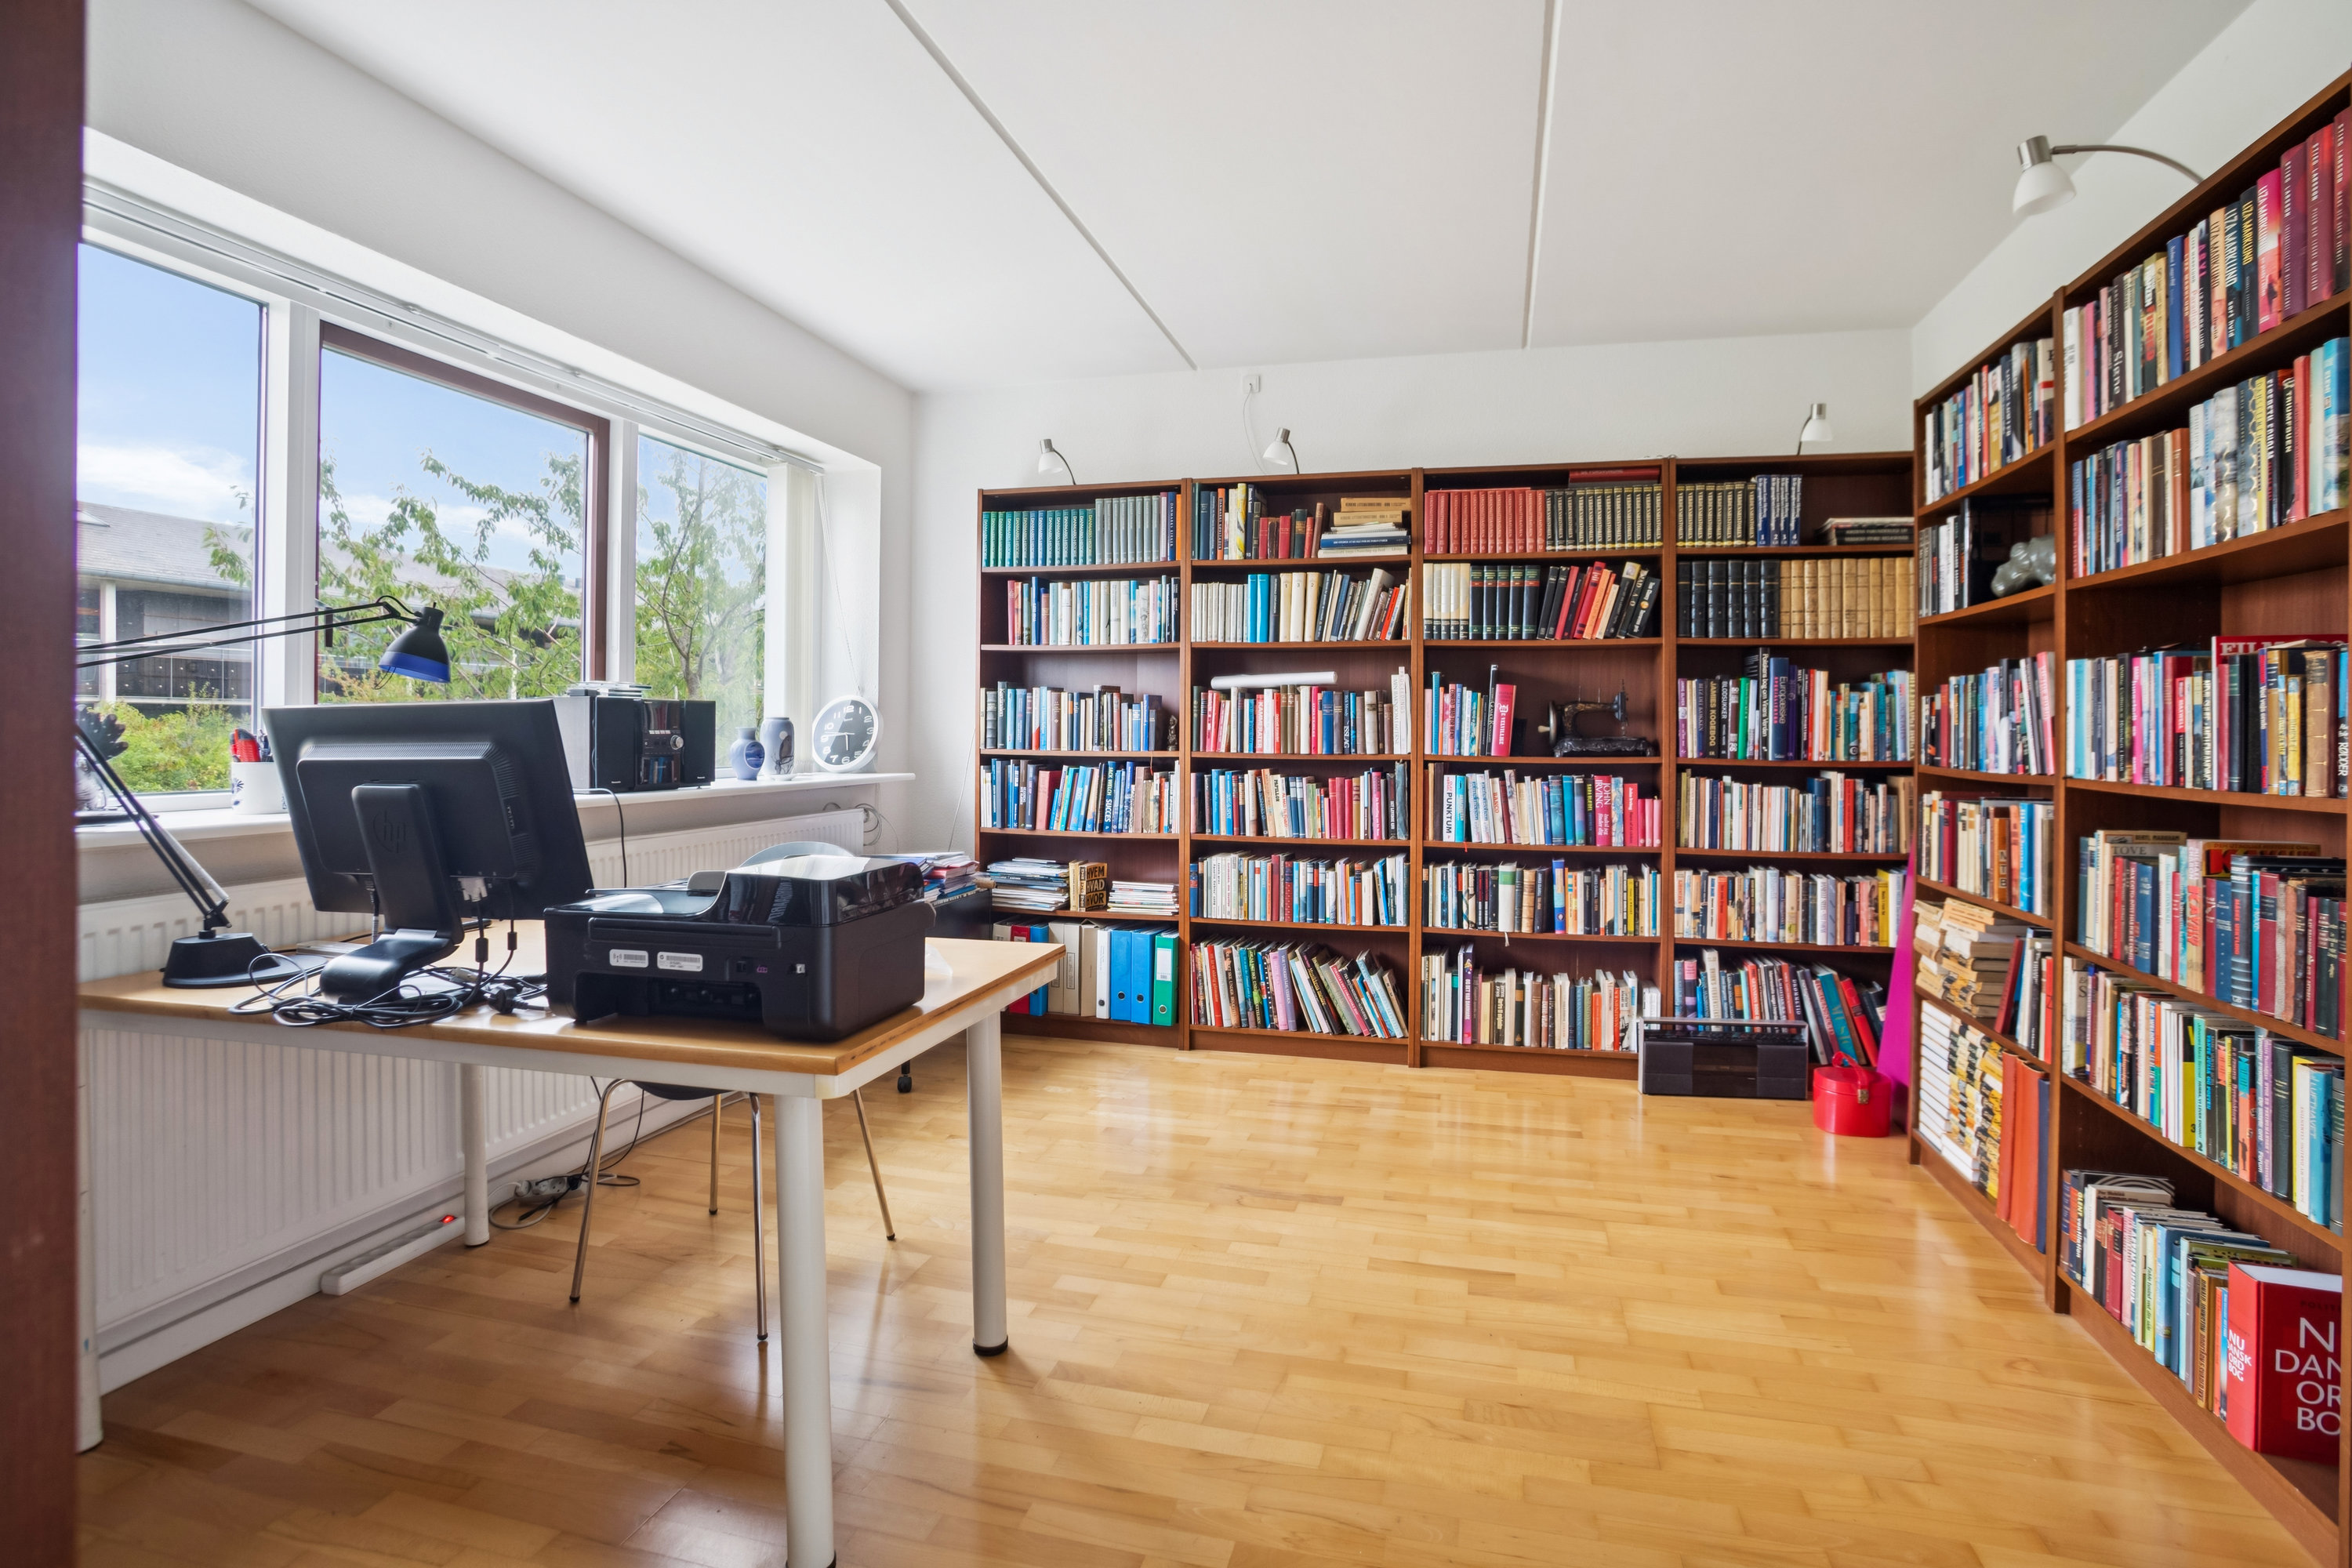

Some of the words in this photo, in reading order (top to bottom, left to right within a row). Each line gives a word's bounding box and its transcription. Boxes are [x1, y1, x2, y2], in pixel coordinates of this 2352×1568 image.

[2258, 186, 2268, 205] LIZA
[2226, 209, 2238, 229] LIZA
[2243, 201, 2253, 219] LIZA
[2211, 221, 2220, 240] LIZA
[2258, 205, 2268, 252] MARKLUND
[2243, 220, 2253, 265] MARKLUND
[2211, 242, 2220, 288] MARKLUND
[2226, 230, 2238, 287] MARKLUND
[1762, 689, 1767, 699] om
[1779, 676, 1788, 724] Europæiske
[1602, 783, 1611, 805] JOHN
[2113, 846, 2147, 855] TOVE
[1087, 866, 1104, 879] HVEM
[1086, 879, 1105, 893] HVAD
[1086, 893, 1104, 906] HVOR
[2229, 1329, 2245, 1351] NU
[2229, 1353, 2244, 1371] ORD
[2228, 1363, 2244, 1382] BOG
